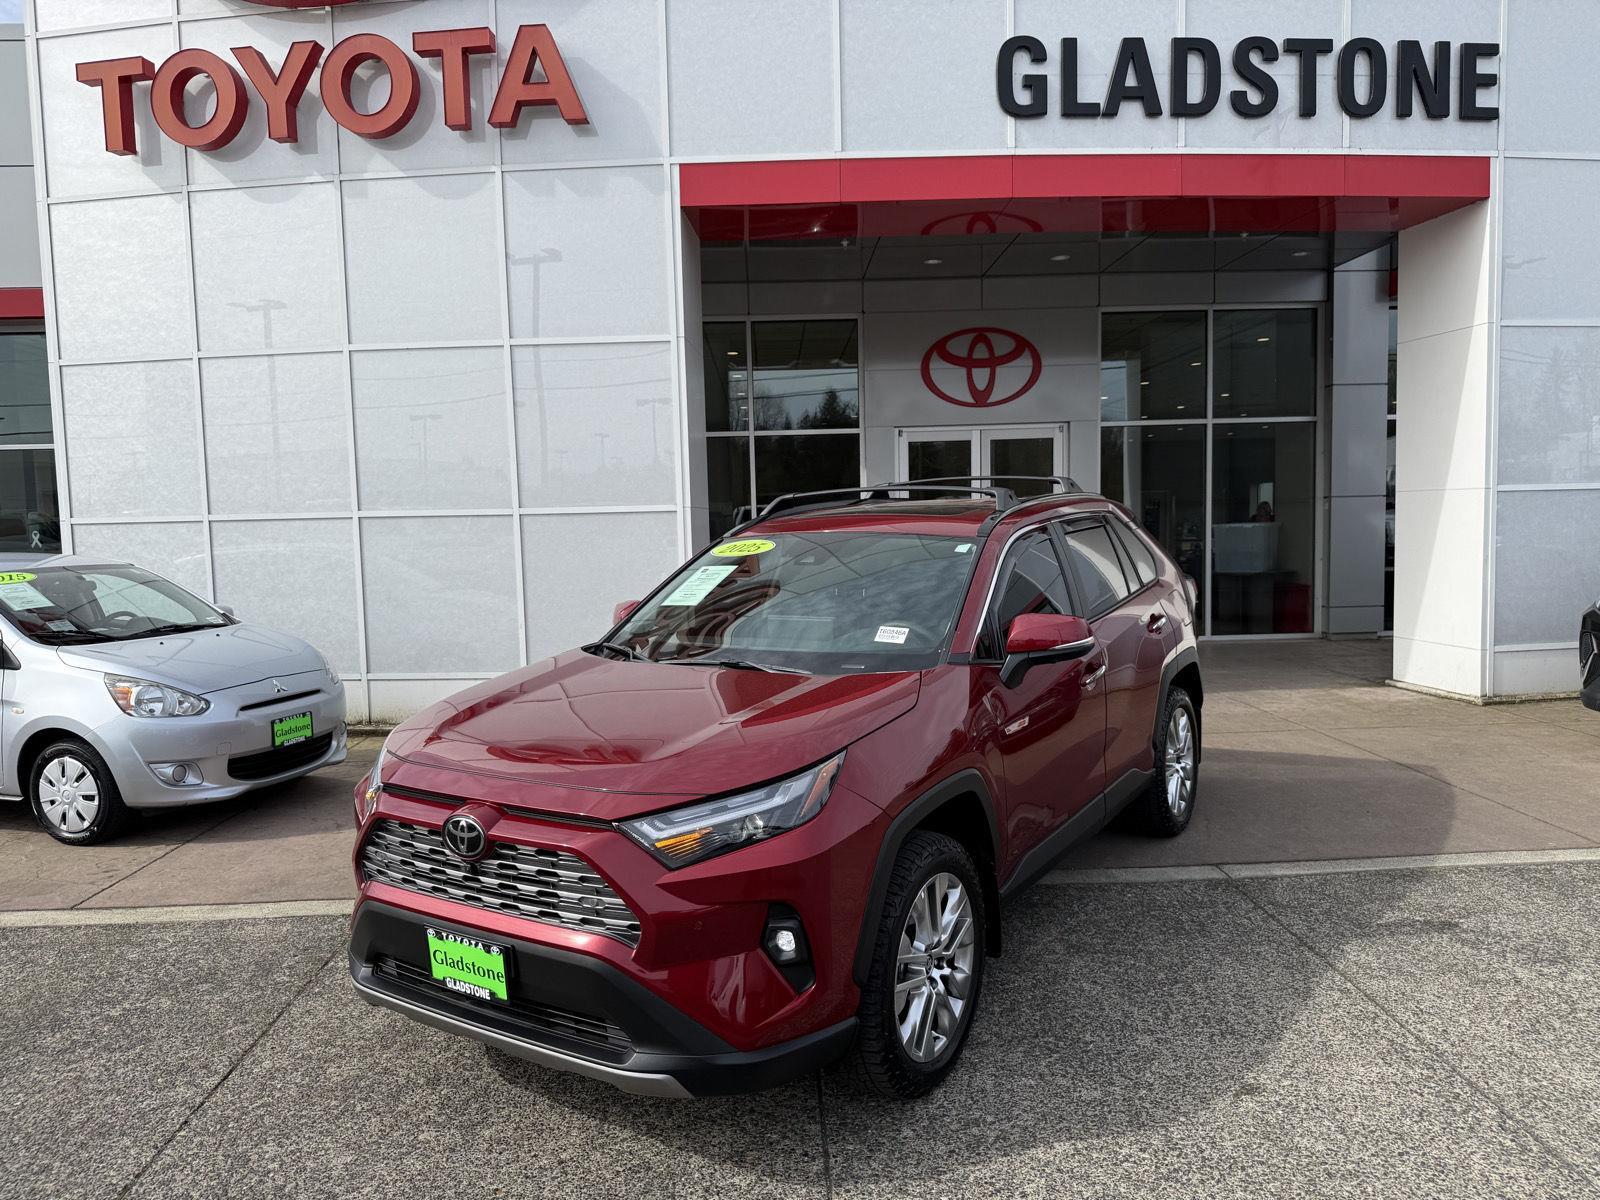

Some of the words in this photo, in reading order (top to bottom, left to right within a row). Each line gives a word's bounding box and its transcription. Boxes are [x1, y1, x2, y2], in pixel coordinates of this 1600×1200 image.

[76, 24, 589, 156] TOYOTA
[996, 35, 1500, 121] GLADSTONE
[276, 724, 311, 738] Gladstone
[441, 932, 484, 950] TOYOTA
[433, 950, 504, 983] Gladstone
[446, 978, 491, 1000] GLADSTONE
